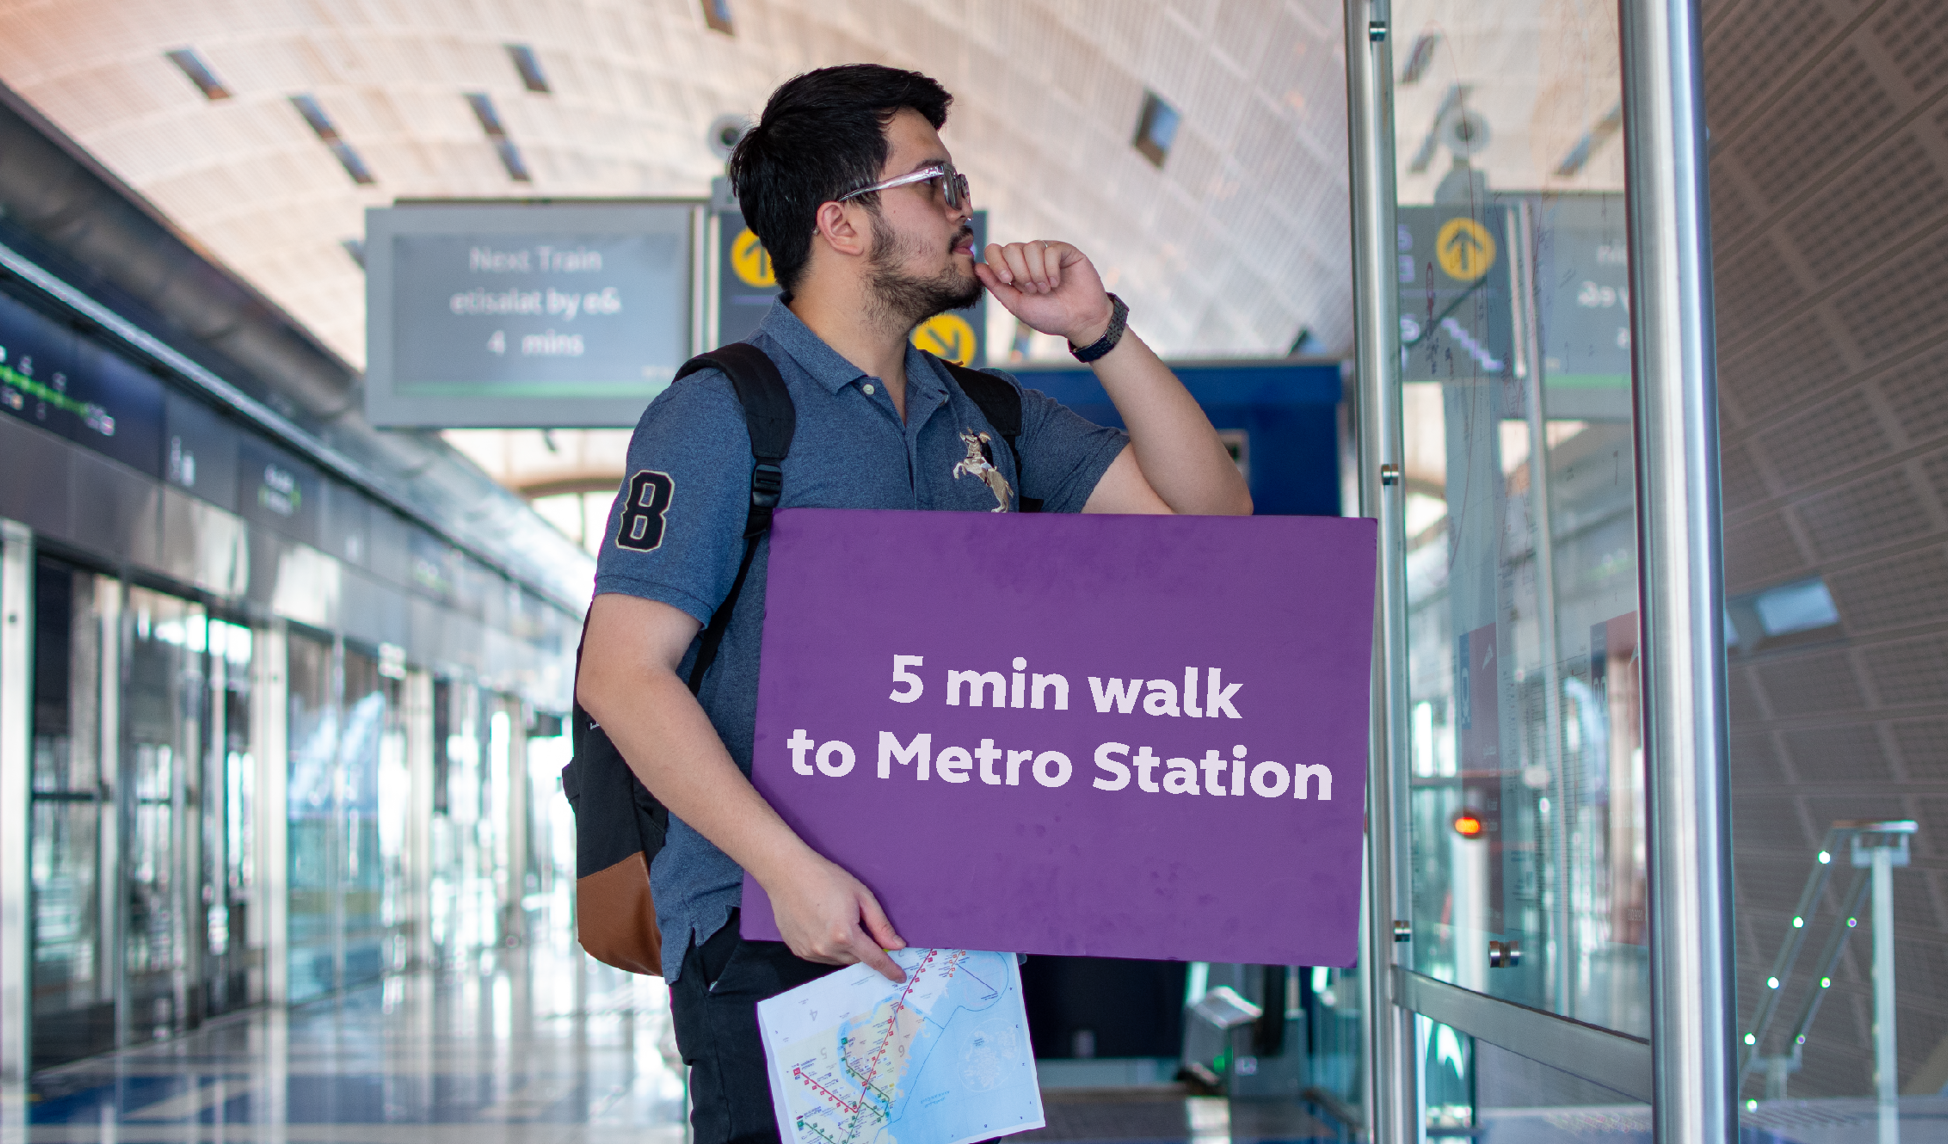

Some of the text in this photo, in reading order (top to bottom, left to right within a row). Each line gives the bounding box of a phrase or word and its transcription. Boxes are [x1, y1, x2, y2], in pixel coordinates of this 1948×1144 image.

[469, 246, 602, 272] Next Train
[450, 287, 542, 314] etisalat
[546, 286, 580, 321] by
[487, 329, 584, 356] 4 mins
[615, 469, 676, 553] 8
[889, 655, 1243, 718] 5 min walk
[787, 729, 1332, 800] to Metro Station
